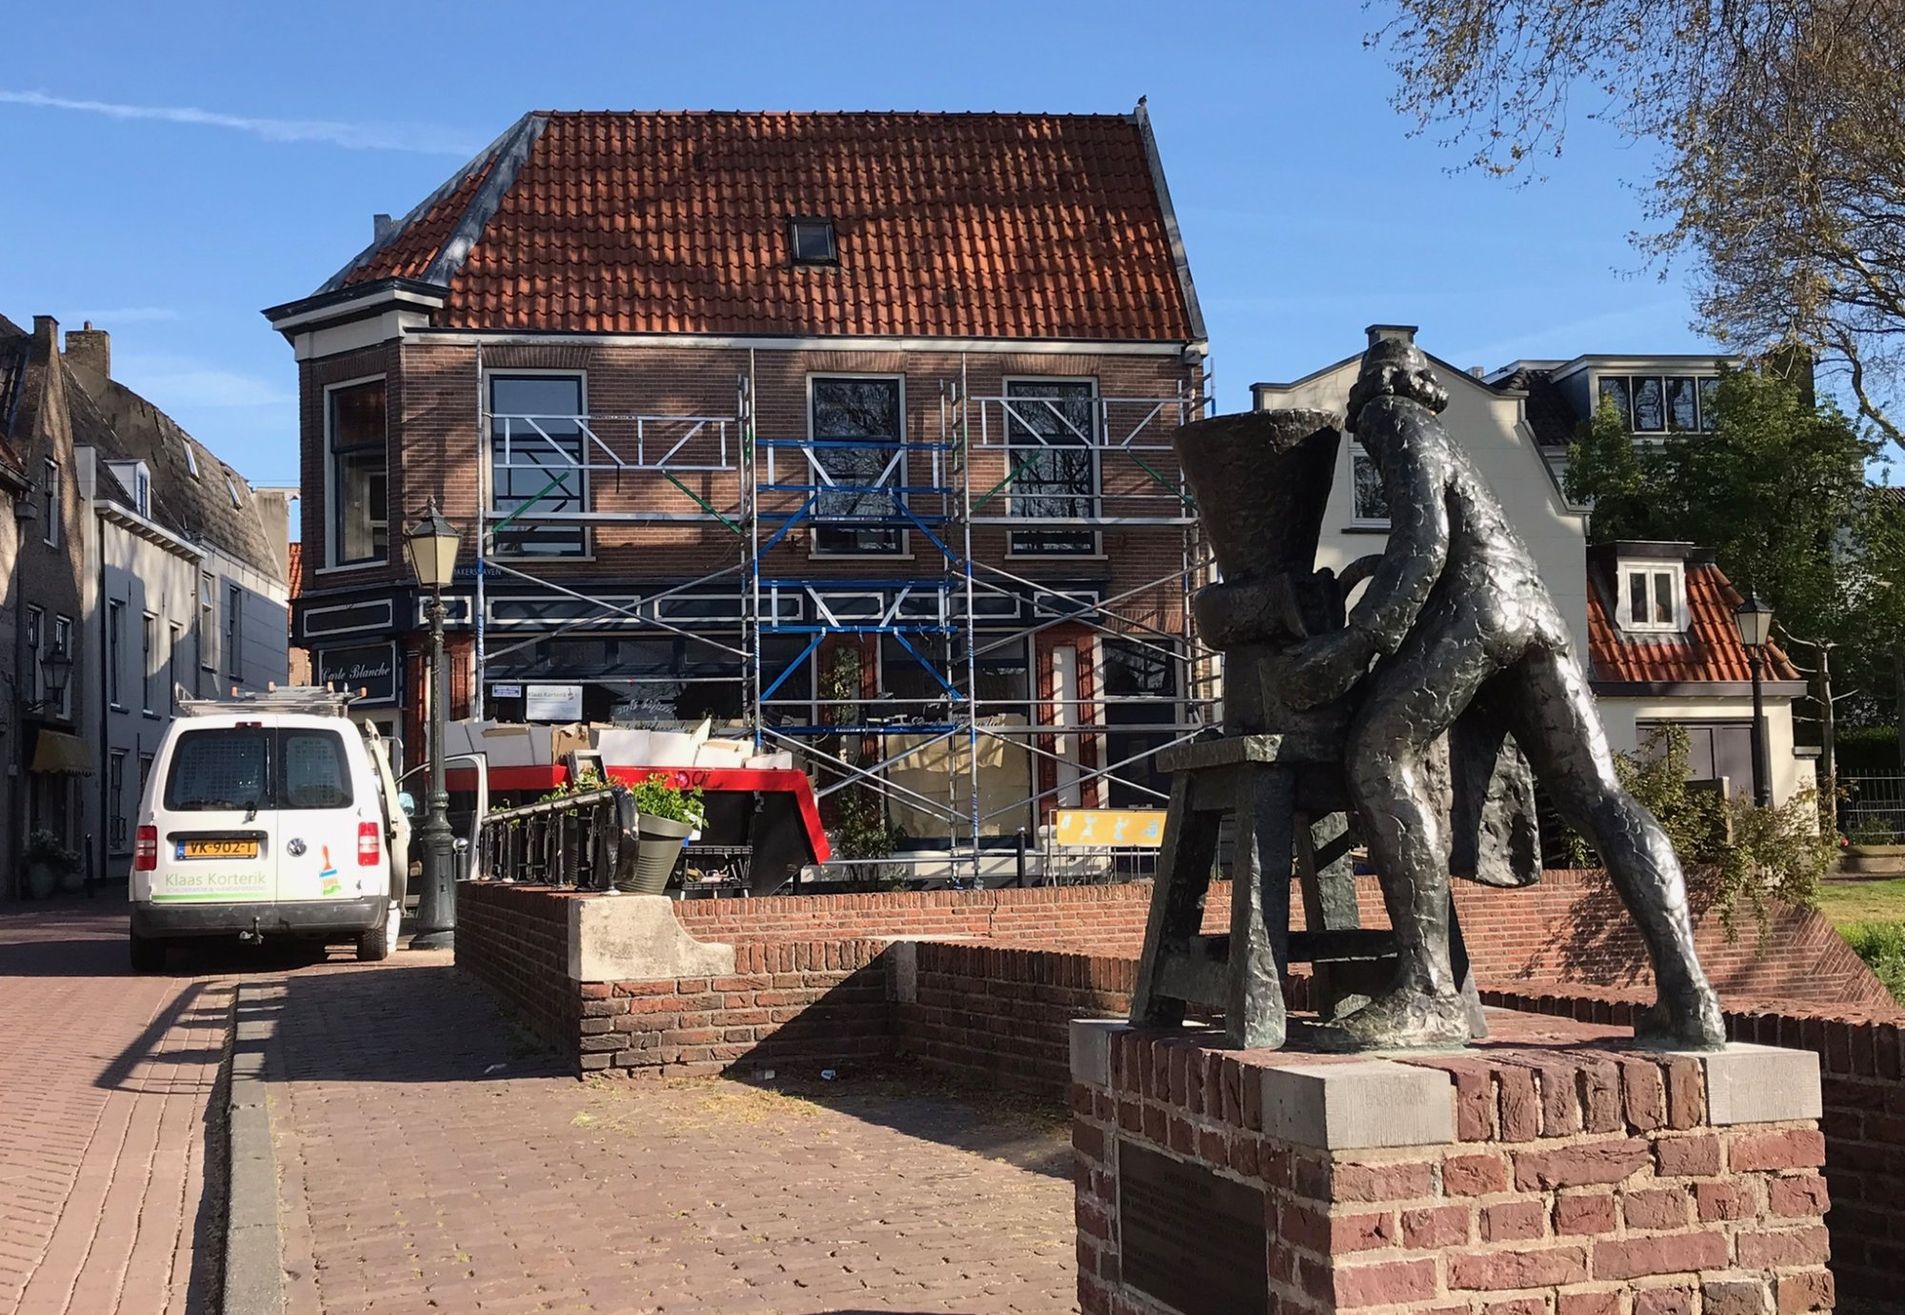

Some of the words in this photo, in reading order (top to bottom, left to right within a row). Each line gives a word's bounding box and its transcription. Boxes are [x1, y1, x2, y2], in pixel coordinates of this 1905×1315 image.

[349, 662, 391, 679] Blanche
[190, 842, 252, 853] VK-902-T
[165, 873, 203, 887] Klaas
[208, 871, 266, 885] Korterik
